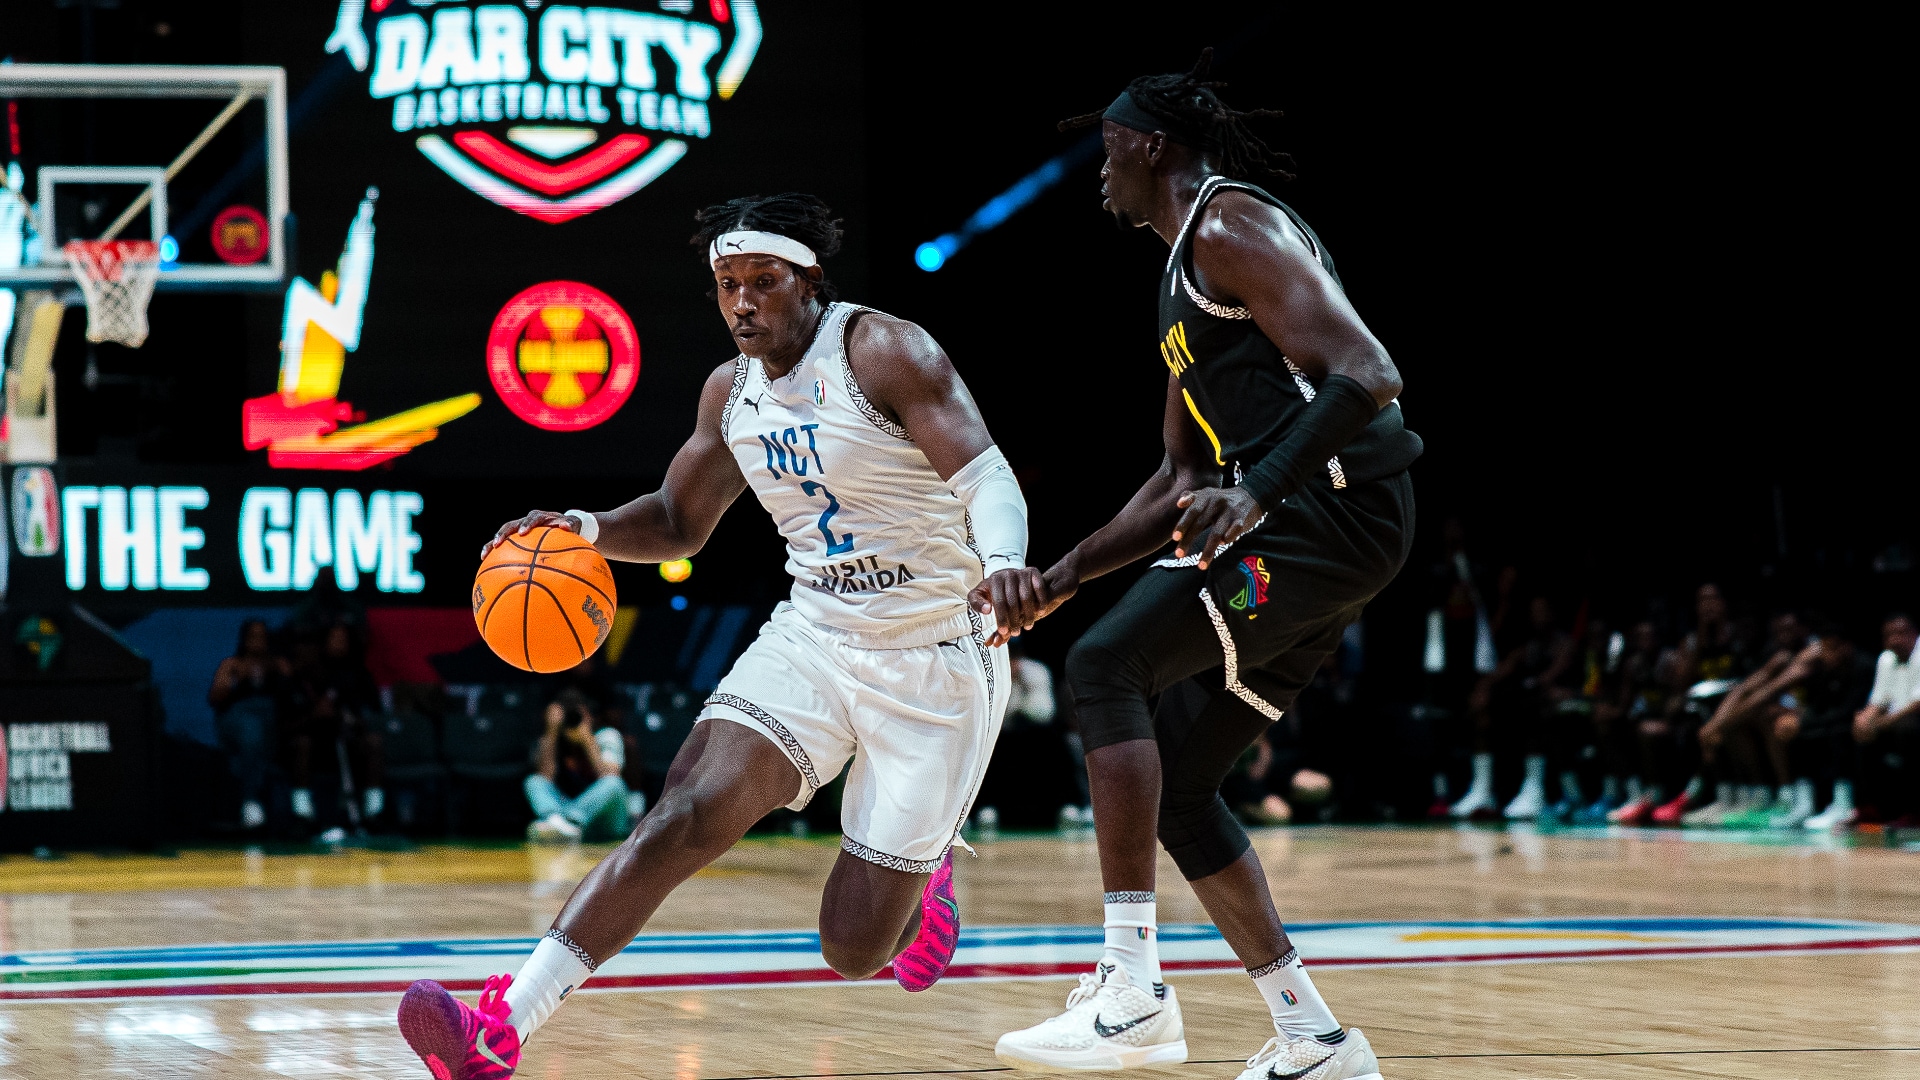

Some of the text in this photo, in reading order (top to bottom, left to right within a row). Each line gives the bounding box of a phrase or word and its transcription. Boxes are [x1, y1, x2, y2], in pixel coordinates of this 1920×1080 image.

[370, 5, 722, 100] DAR CITY
[392, 82, 711, 138] BASKETBALL TEAM
[758, 423, 825, 480] NCT
[62, 486, 425, 593] THE GAME
[800, 479, 855, 557] 2
